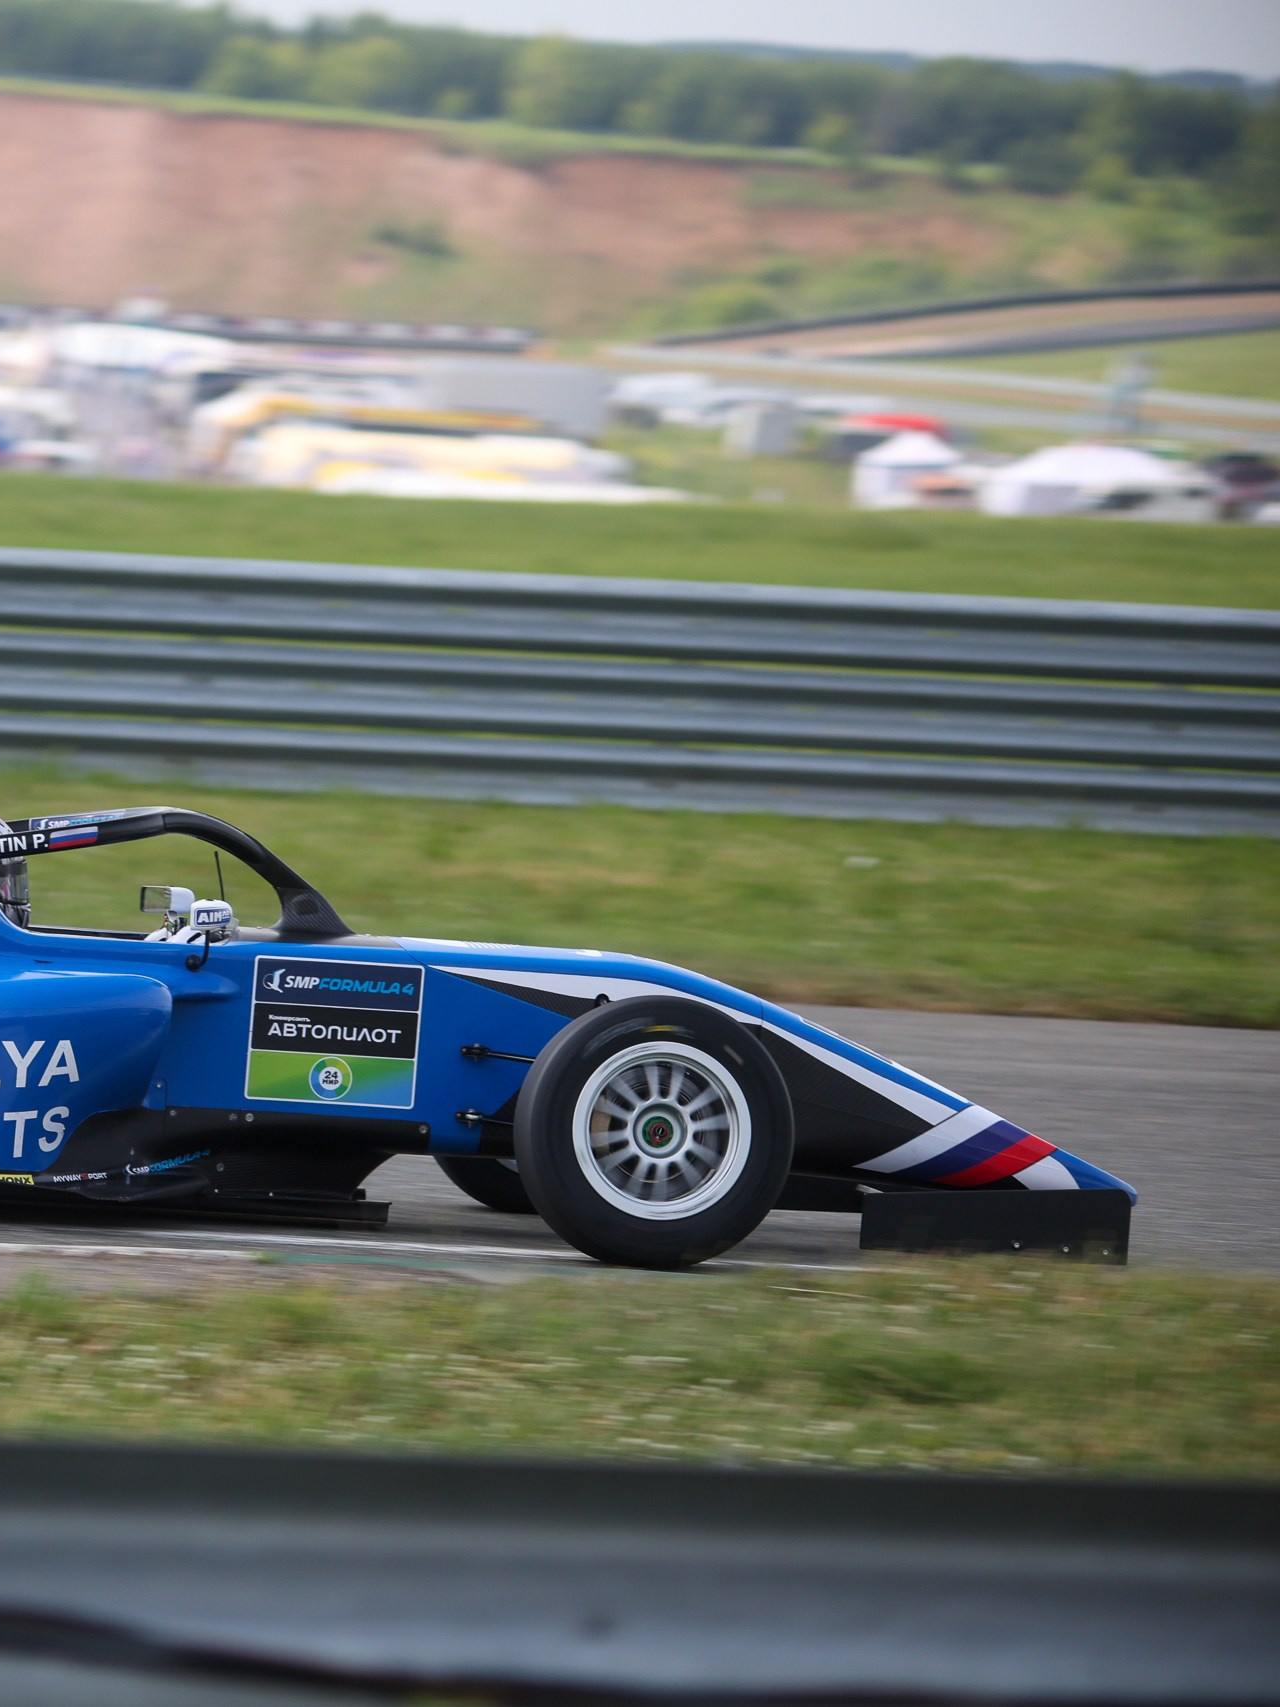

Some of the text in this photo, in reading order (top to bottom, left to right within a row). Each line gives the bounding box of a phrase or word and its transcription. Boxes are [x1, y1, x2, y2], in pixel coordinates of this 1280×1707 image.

[33, 833, 49, 849] P.
[267, 1022, 402, 1043] АВТОПИЛОТ
[324, 1070, 338, 1079] 24
